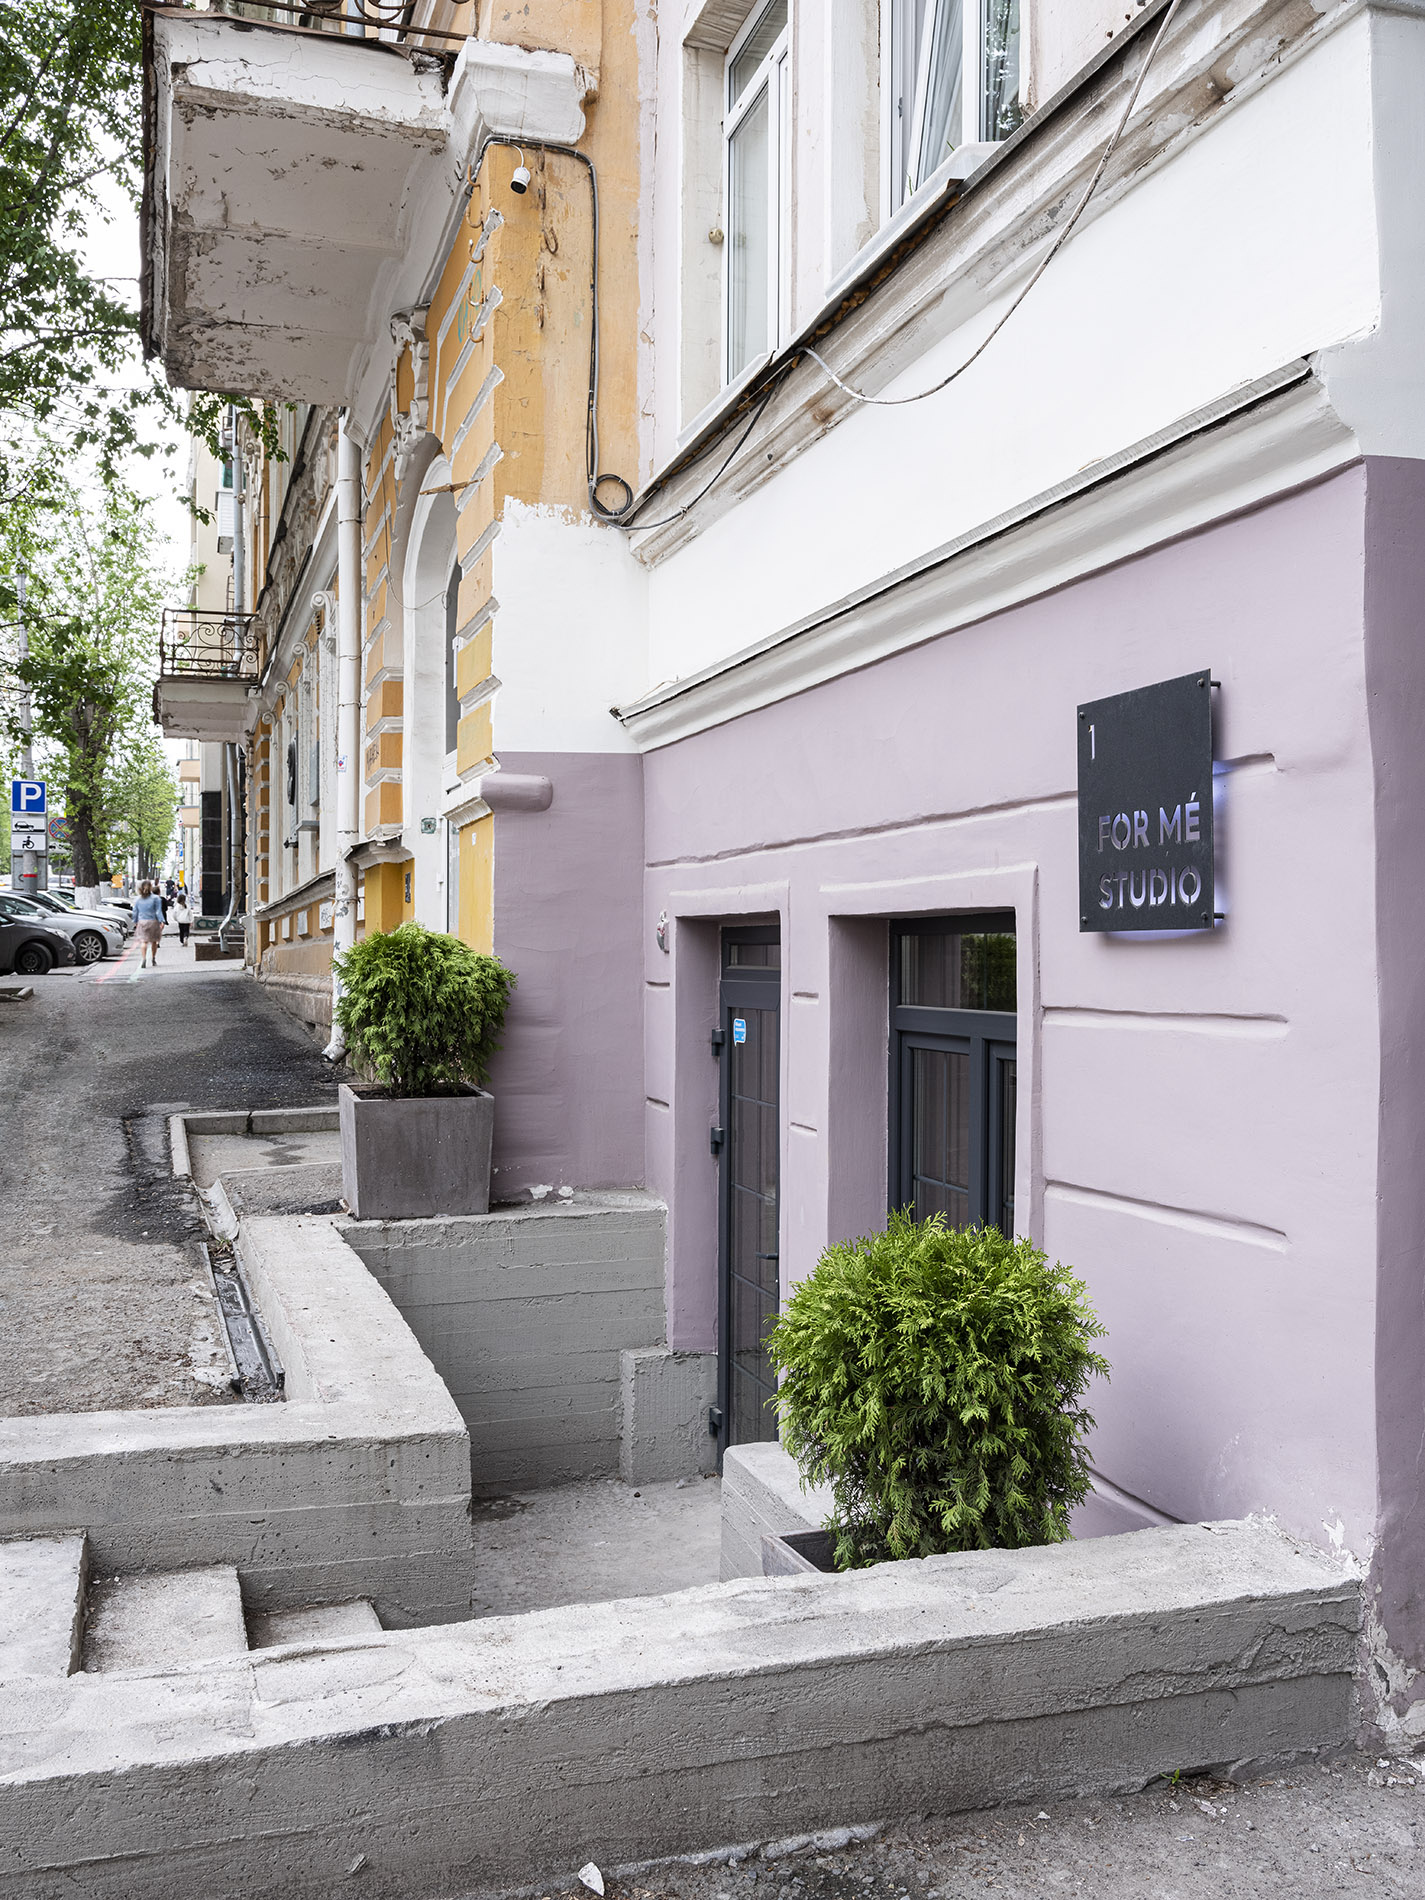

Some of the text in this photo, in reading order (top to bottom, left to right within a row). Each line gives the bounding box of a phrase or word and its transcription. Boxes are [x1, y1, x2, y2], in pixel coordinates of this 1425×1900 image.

[20, 783, 42, 810] P
[1097, 791, 1200, 852] FOR MÉ
[1099, 865, 1201, 910] STUDIO
